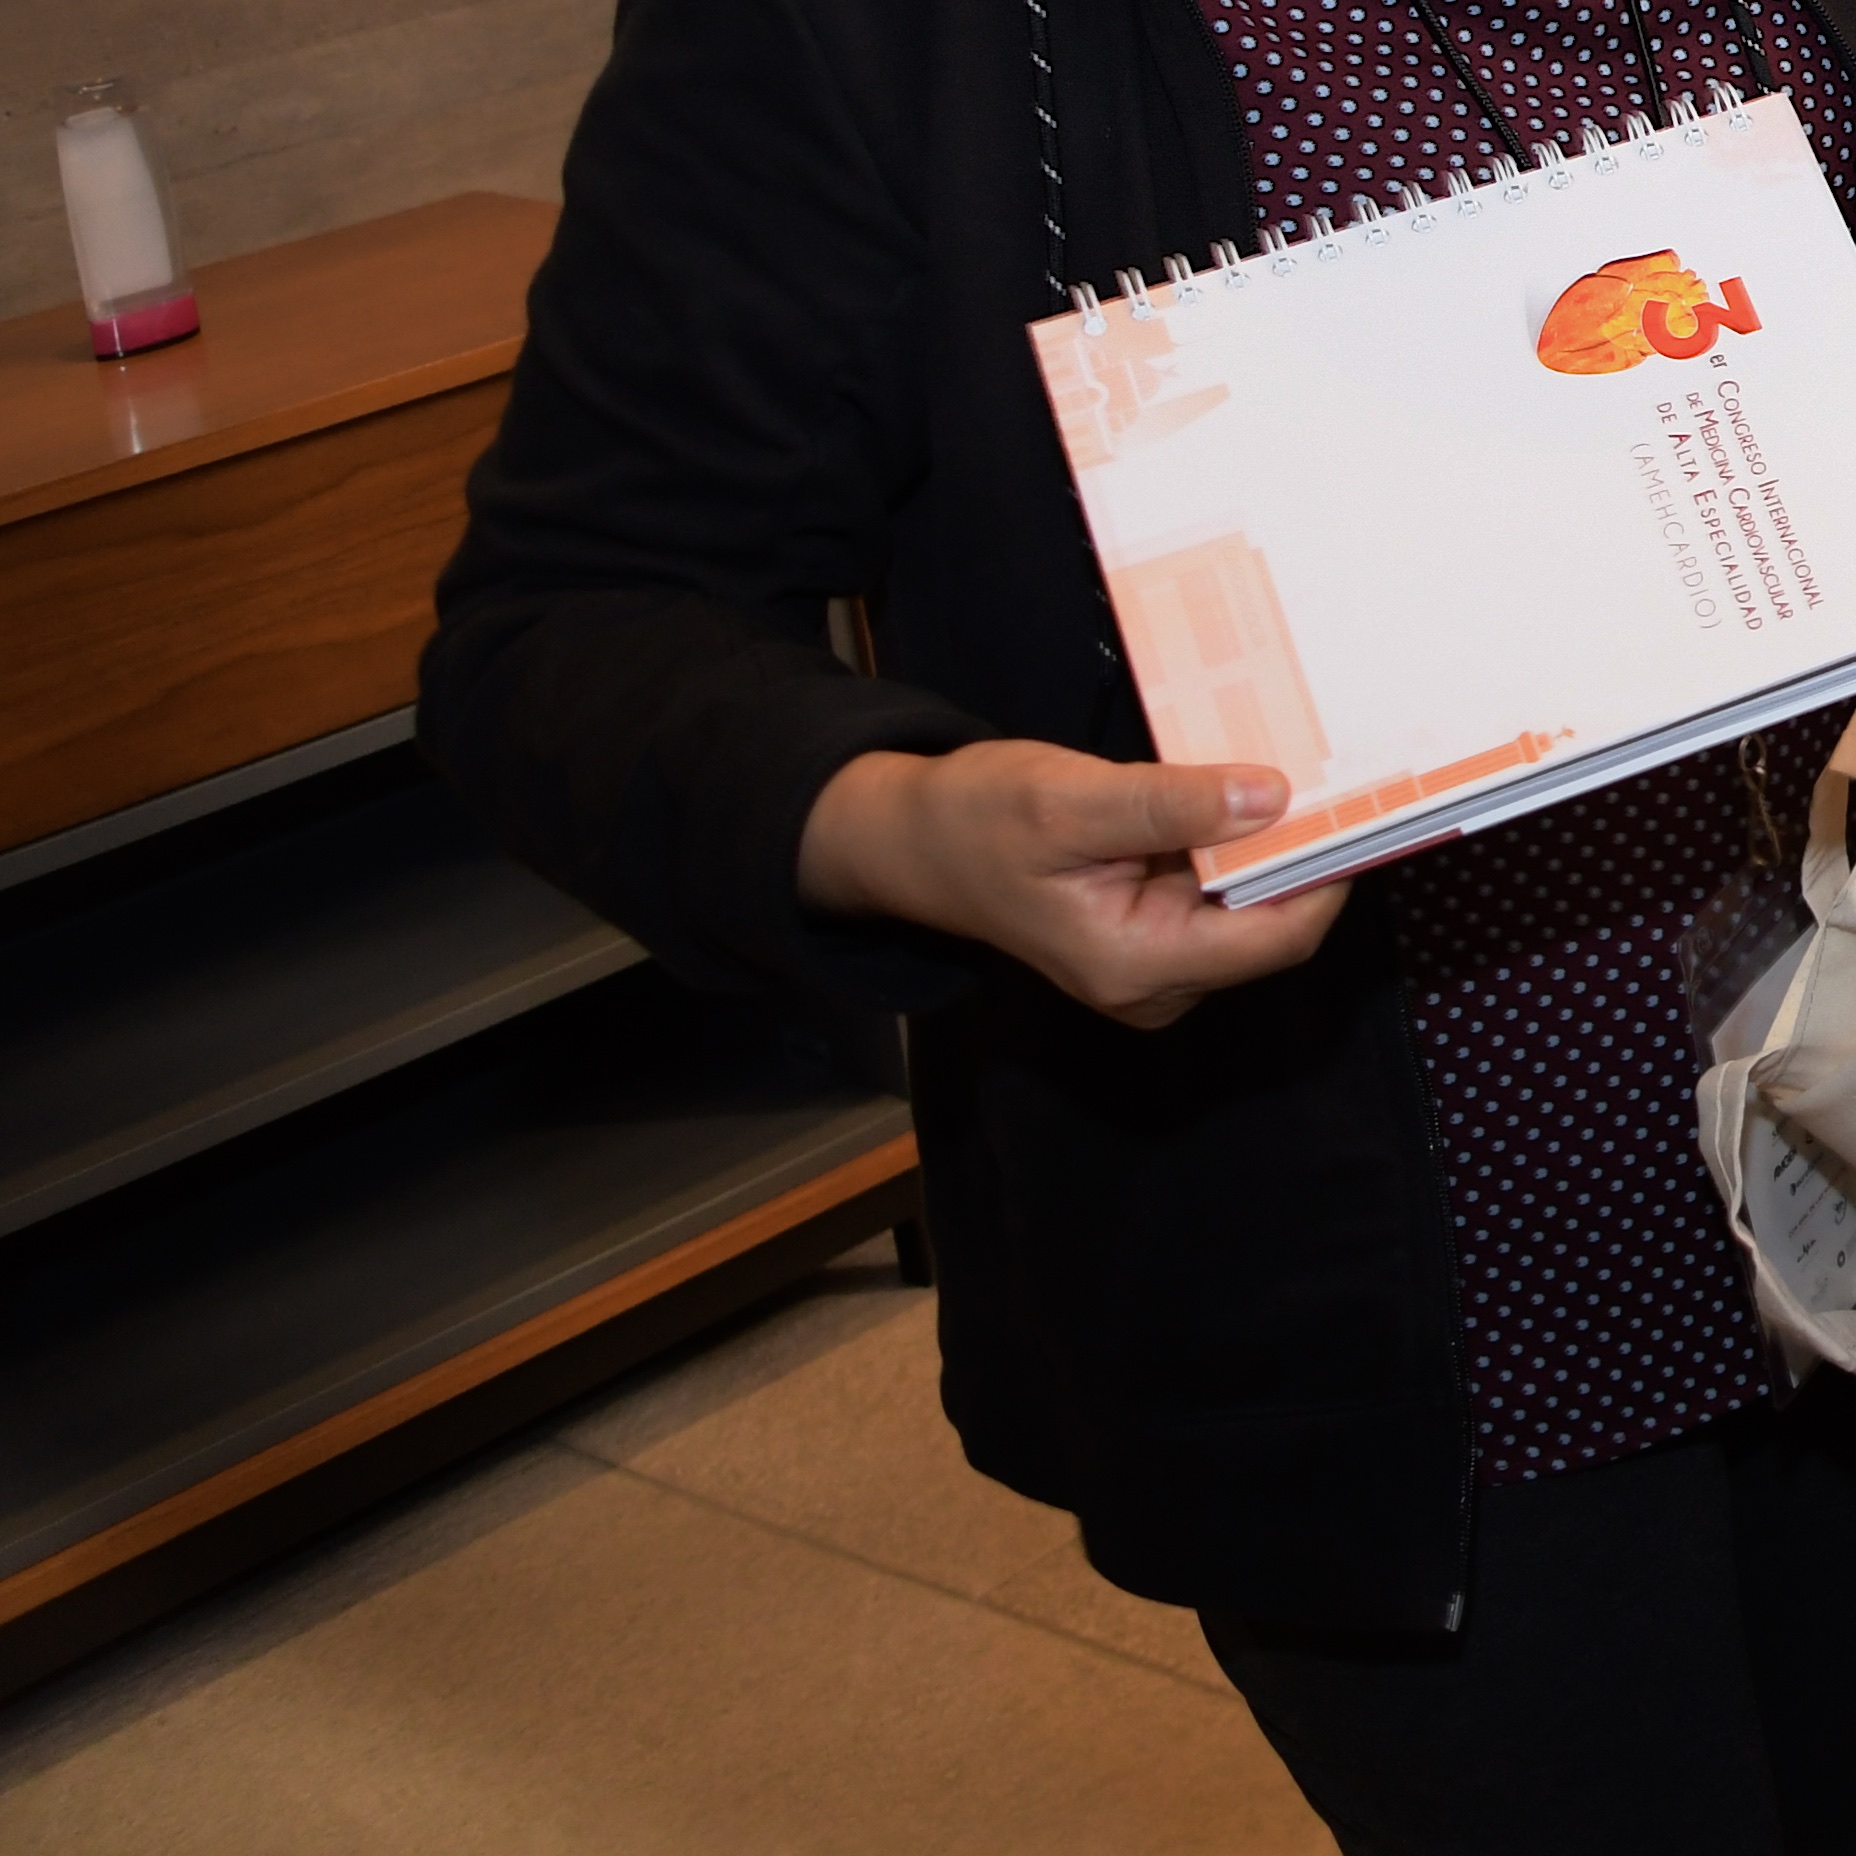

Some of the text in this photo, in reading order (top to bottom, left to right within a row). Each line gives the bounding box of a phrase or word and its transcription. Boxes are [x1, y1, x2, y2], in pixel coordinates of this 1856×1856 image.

[1630, 442, 1722, 629] (AMEHCARDIO)
[1656, 401, 1763, 631] DE ALTA ESPECIALIDAD
[1686, 392, 1794, 620] DE MEDICINA CARDIOVASCULAR
[1717, 380, 1824, 610] CONGRESO INTERNACIONAL
